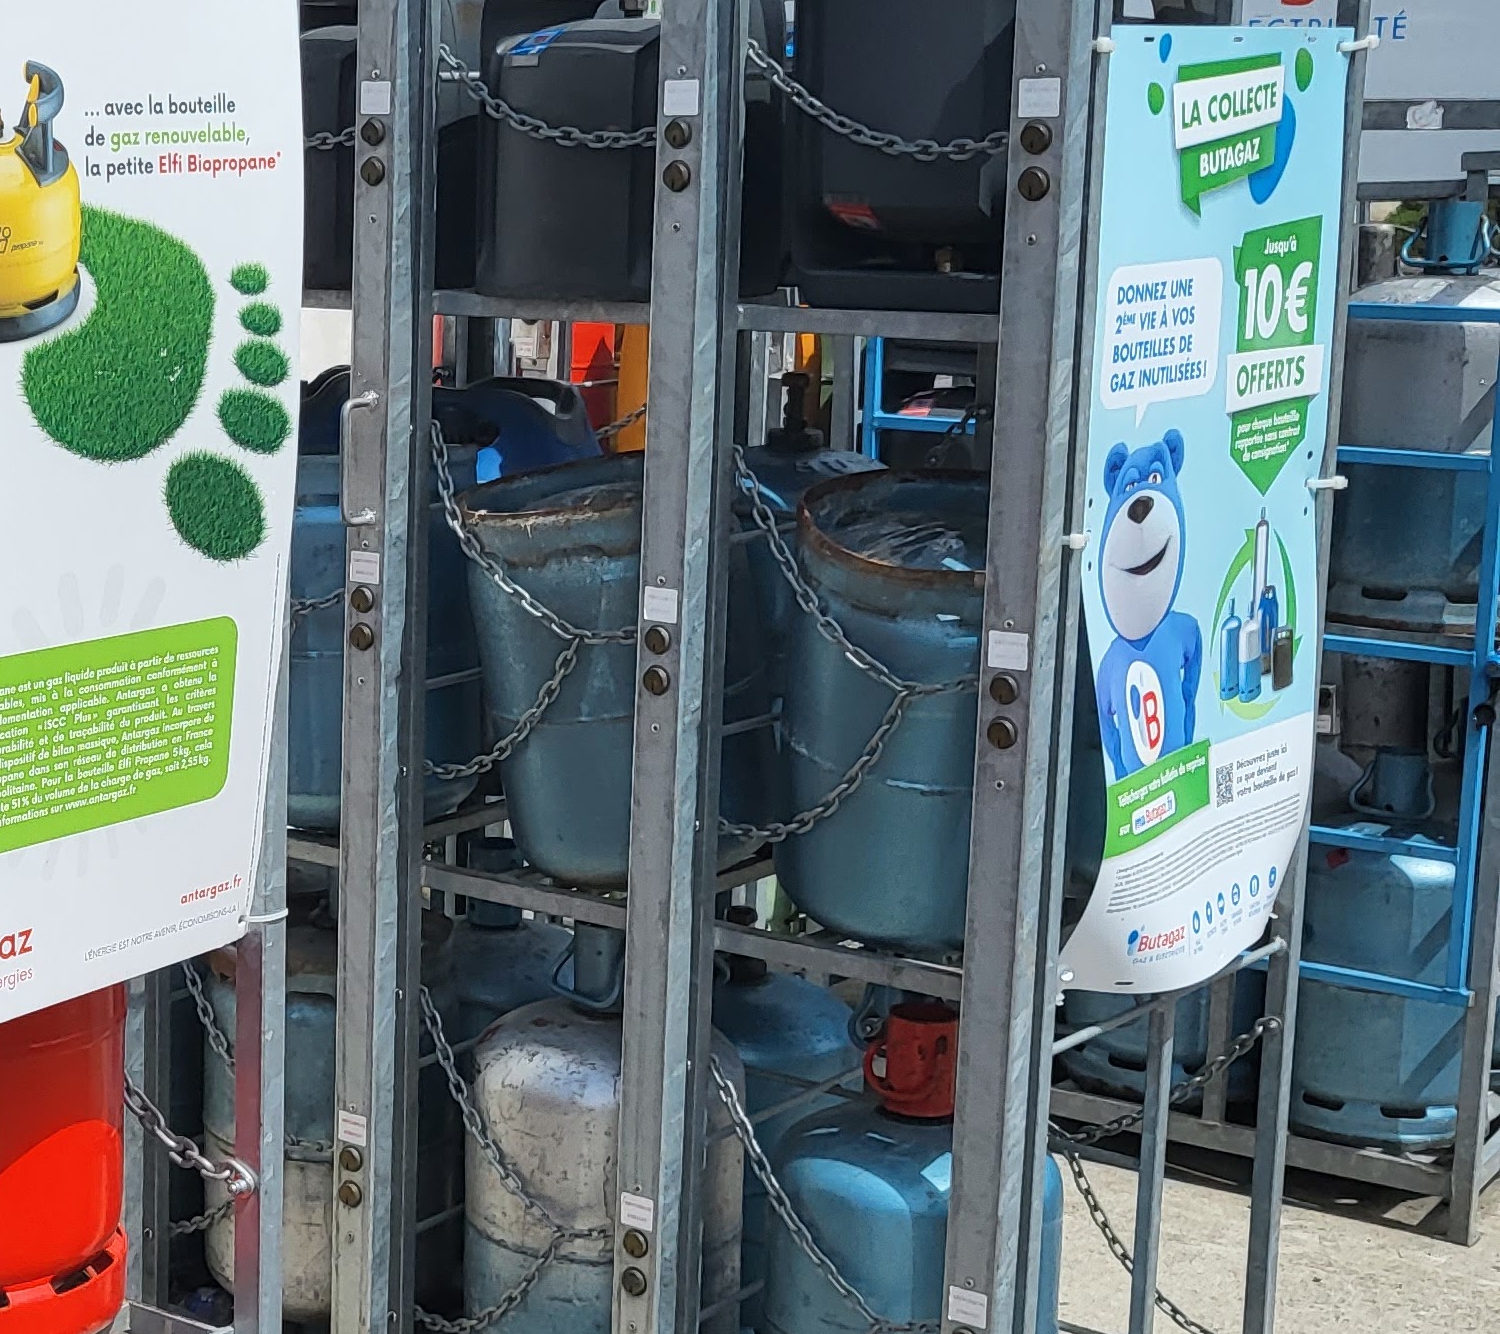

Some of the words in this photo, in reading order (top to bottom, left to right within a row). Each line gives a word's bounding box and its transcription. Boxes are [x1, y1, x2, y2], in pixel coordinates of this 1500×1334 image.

[104, 99, 144, 116] avec
[148, 94, 163, 115] la
[168, 93, 236, 115] bouteille
[1182, 100, 1201, 130] LA
[1207, 80, 1277, 124] COLLECTE
[85, 124, 106, 147] de
[110, 130, 141, 153] gaz
[145, 123, 251, 147] renouvelable,
[85, 156, 102, 177] la
[106, 158, 154, 183] petite
[158, 154, 183, 175] Elfi
[1199, 137, 1260, 178] BUTAGAZ
[1263, 234, 1297, 257] Jusqu'à
[1117, 280, 1167, 305] DONNEZ
[1171, 278, 1194, 299] UNE
[1244, 261, 1313, 340] 10€
[1139, 310, 1157, 331] VIE
[1159, 303, 1168, 329] À
[1172, 306, 1195, 327] VOS
[1112, 336, 1175, 363] BOUTEILLES
[1179, 334, 1193, 353] DE
[1110, 371, 1135, 393] GAZ
[1236, 355, 1306, 397] OFFERTS
[18, 681, 31, 693] est
[33, 678, 44, 689] un
[46, 675, 63, 690] gaz
[64, 668, 95, 685] liquide
[96, 662, 129, 680] produit
[130, 659, 136, 670] à
[137, 655, 162, 672] partir
[164, 651, 174, 663] de
[176, 646, 219, 661] ressources
[31, 693, 47, 705] mis
[52, 689, 59, 700] à
[64, 686, 73, 698] la
[79, 675, 141, 694] consommation
[146, 660, 207, 681] conformément
[211, 658, 218, 668] à
[60, 695, 110, 714] applicable.
[115, 686, 155, 701] Antargaz
[161, 683, 168, 692] a
[173, 676, 203, 689] obtenu
[208, 671, 217, 682] la
[106, 697, 159, 719] garantissant
[167, 693, 179, 704] les
[185, 686, 217, 700] critères
[38, 735, 48, 746] et
[52, 730, 65, 743] de
[69, 720, 115, 739] traçabilité
[119, 717, 130, 728] du
[134, 710, 167, 728] produit.
[172, 706, 183, 717] Au
[187, 700, 216, 714] travers
[38, 747, 49, 761] de
[52, 744, 75, 758] bilan
[77, 736, 119, 751] massique,
[121, 727, 160, 742] Antargaz
[162, 718, 202, 733] incorpore
[204, 713, 215, 724] du
[28, 764, 50, 778] dans
[53, 760, 69, 771] son
[73, 752, 102, 766] réseau
[106, 747, 117, 759] de
[120, 736, 168, 756] distribution
[171, 734, 182, 744] en
[185, 727, 214, 741] France
[41, 776, 62, 788] Pour
[64, 771, 74, 783] la
[77, 761, 115, 780] bouteille
[118, 757, 132, 770] Elfi
[134, 751, 170, 767] Propane
[194, 739, 213, 752] cela
[31, 792, 43, 805] du
[45, 786, 75, 801] volume
[77, 781, 89, 794] de
[90, 779, 100, 790] la
[101, 771, 131, 788] charge
[133, 768, 144, 781] de
[145, 765, 163, 781] gaz,
[165, 760, 180, 773] soit
[50, 803, 64, 814] sur
[65, 784, 137, 810] www.antargaz.fr
[180, 873, 242, 905] antargaz.fr
[118, 939, 129, 953] EST
[130, 931, 153, 946] NOTRE
[1137, 925, 1185, 952] Butagaz
